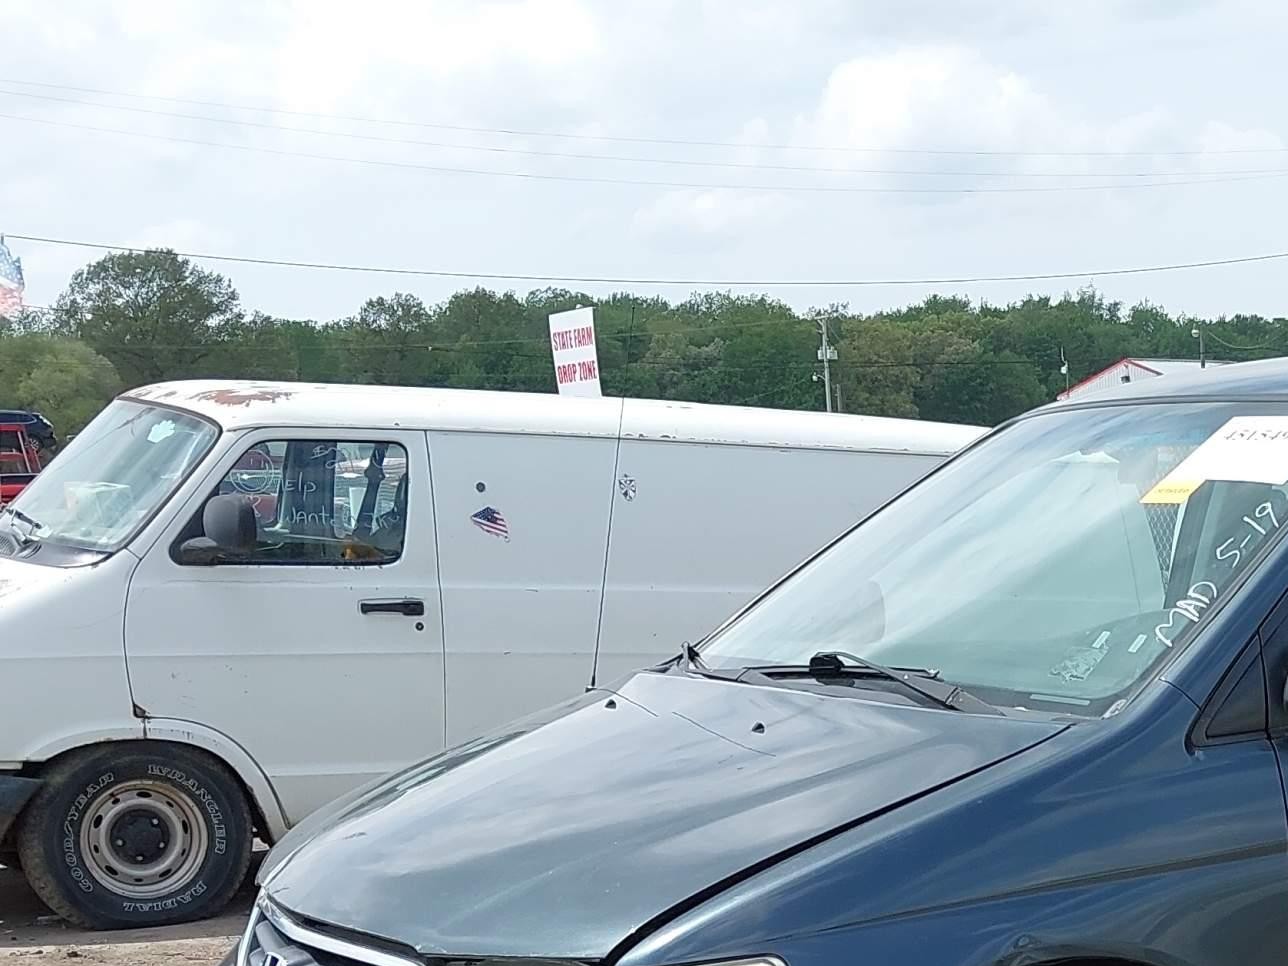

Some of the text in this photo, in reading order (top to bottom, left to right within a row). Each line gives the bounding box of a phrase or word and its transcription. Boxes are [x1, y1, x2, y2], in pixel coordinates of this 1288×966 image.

[552, 326, 593, 351] STATE FARM
[557, 360, 597, 384] DROP ZONE
[1155, 502, 1279, 647] MAD 5-19
[148, 764, 226, 854] WRANGLER
[123, 880, 207, 912] RADIAL
